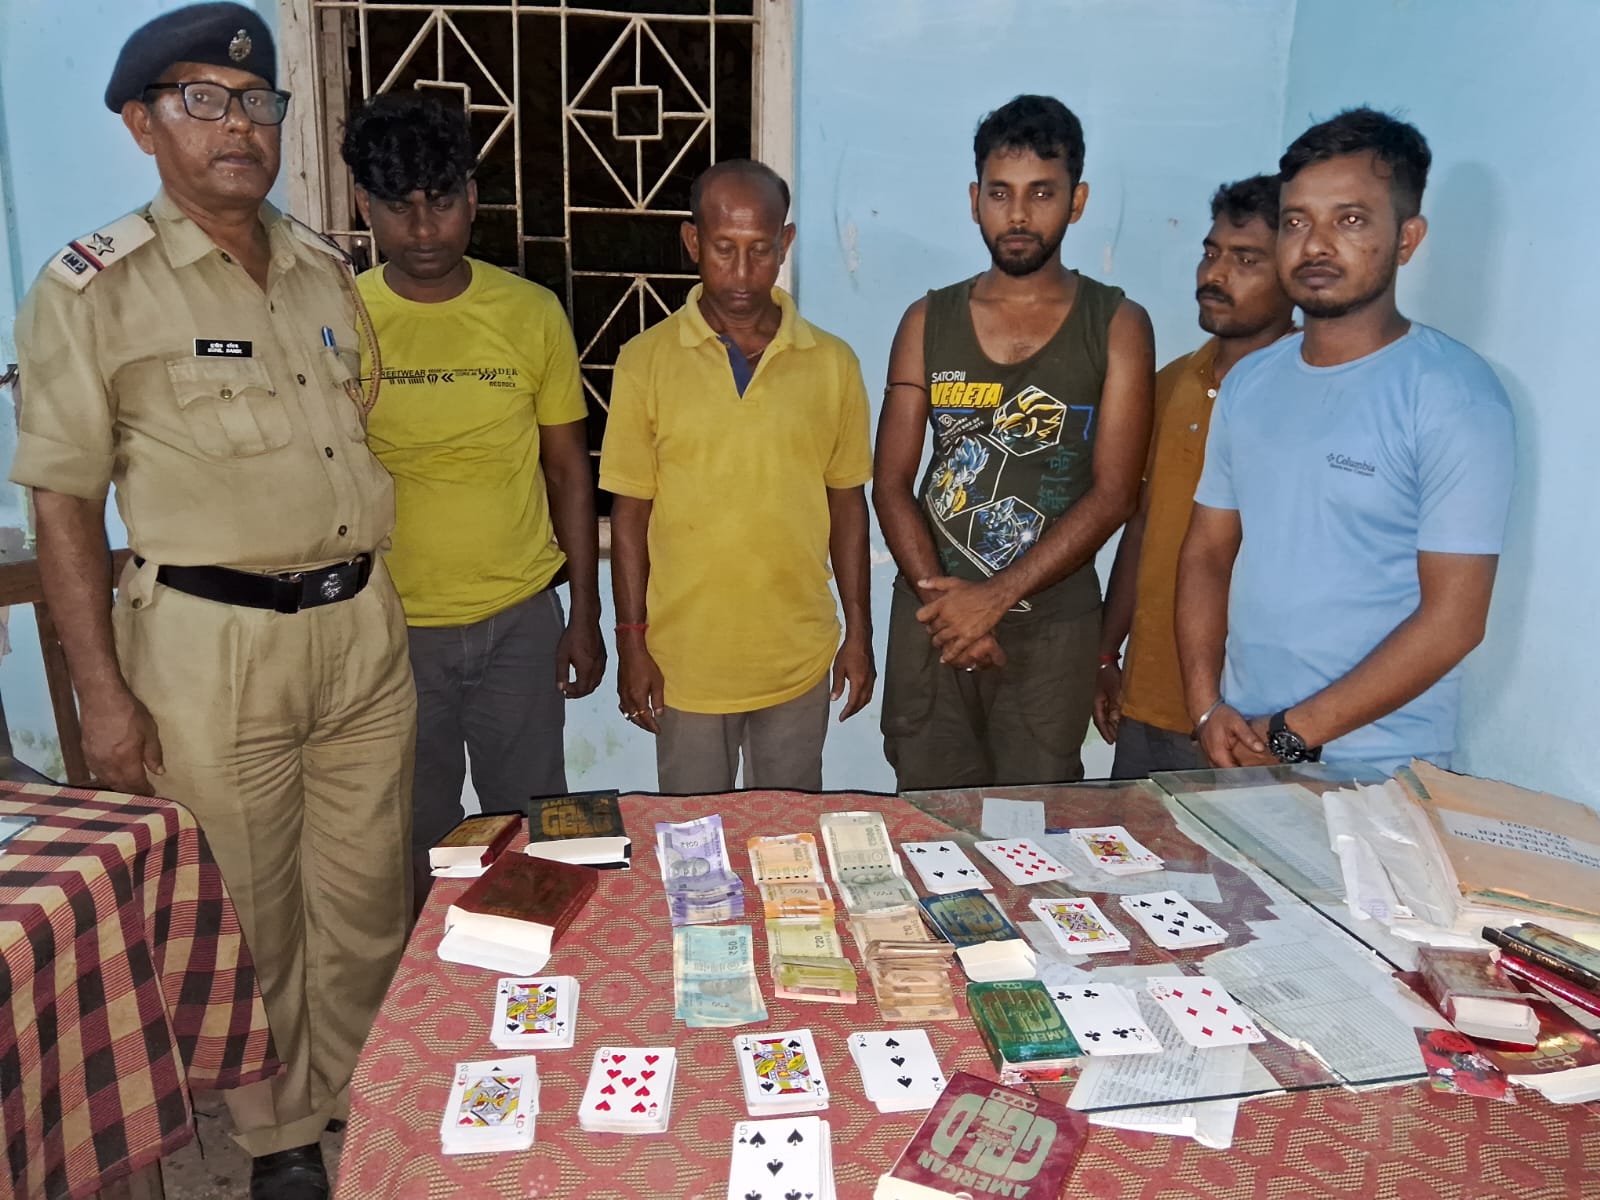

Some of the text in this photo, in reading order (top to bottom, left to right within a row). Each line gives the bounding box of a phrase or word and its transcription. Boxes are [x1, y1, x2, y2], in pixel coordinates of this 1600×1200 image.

[380, 369, 426, 377] REETWEAR
[478, 367, 519, 376] LEADER
[931, 370, 967, 383] SATORU
[930, 382, 1004, 408] VEGETA
[1335, 453, 1376, 473] Columbia
[1453, 829, 1514, 847] STATION
[1477, 828, 1549, 848] REGISTER
[1519, 843, 1571, 860] POLICE
[728, 940, 738, 956] ₹50
[738, 1124, 749, 1136] 5
[931, 1093, 1058, 1181] GOLD
[917, 1150, 1032, 1200] AMERICAN
